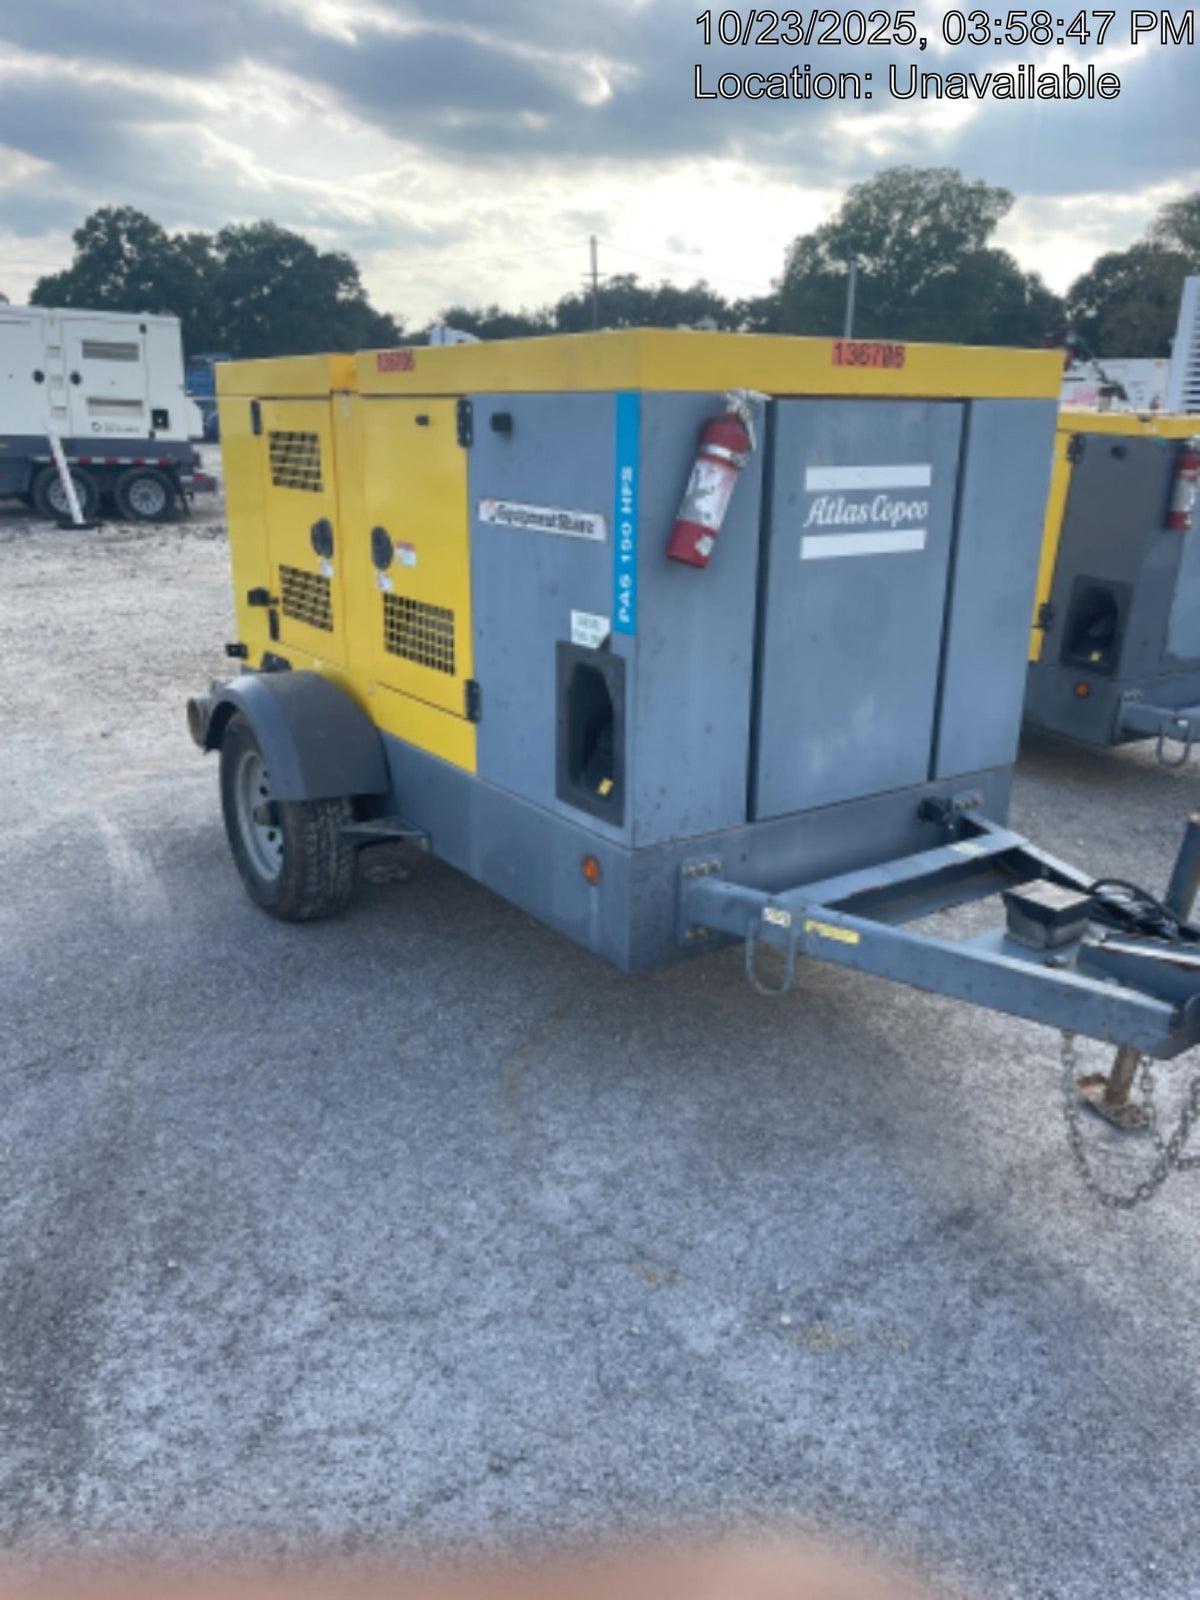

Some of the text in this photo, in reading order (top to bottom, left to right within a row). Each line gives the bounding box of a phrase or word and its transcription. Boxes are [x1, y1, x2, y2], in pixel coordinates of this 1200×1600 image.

[802, 494, 929, 528] Atlas Copco
[618, 573, 633, 624] PAS
